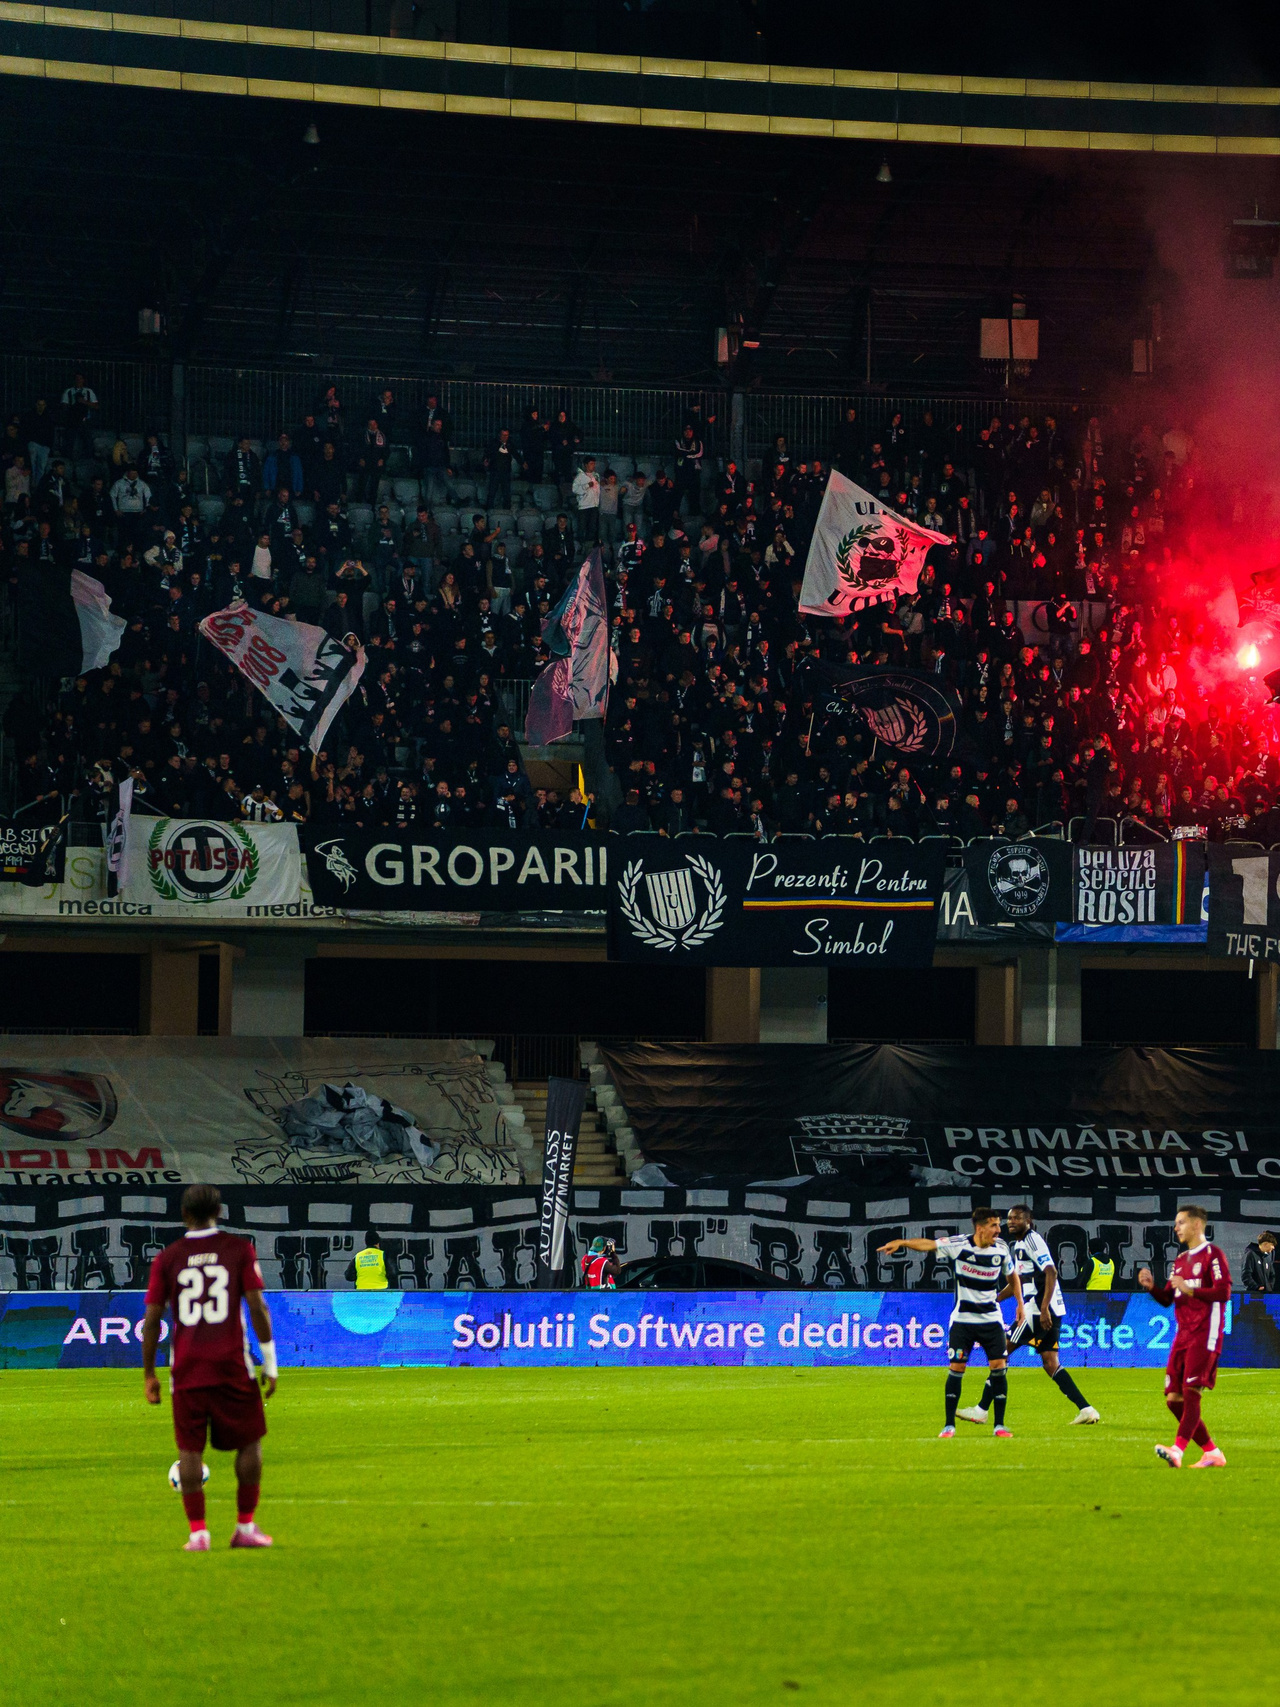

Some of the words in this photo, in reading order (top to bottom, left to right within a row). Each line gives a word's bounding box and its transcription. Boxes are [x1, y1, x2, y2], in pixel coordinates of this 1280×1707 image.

[364, 843, 607, 886] GROPARII
[854, 858, 928, 895] Pentru
[792, 919, 894, 955] Simbol
[1226, 933, 1261, 957] THE
[944, 1123, 1191, 1150] PRIMĂRIA
[4, 1169, 182, 1186] Tractoare
[558, 1131, 575, 1197] MARKET
[953, 1154, 1225, 1179] CONSILIUL
[540, 1129, 561, 1267] AUTOKLASS
[177, 1264, 229, 1327] 23
[453, 1313, 575, 1349] Solutii
[588, 1314, 766, 1349] Software
